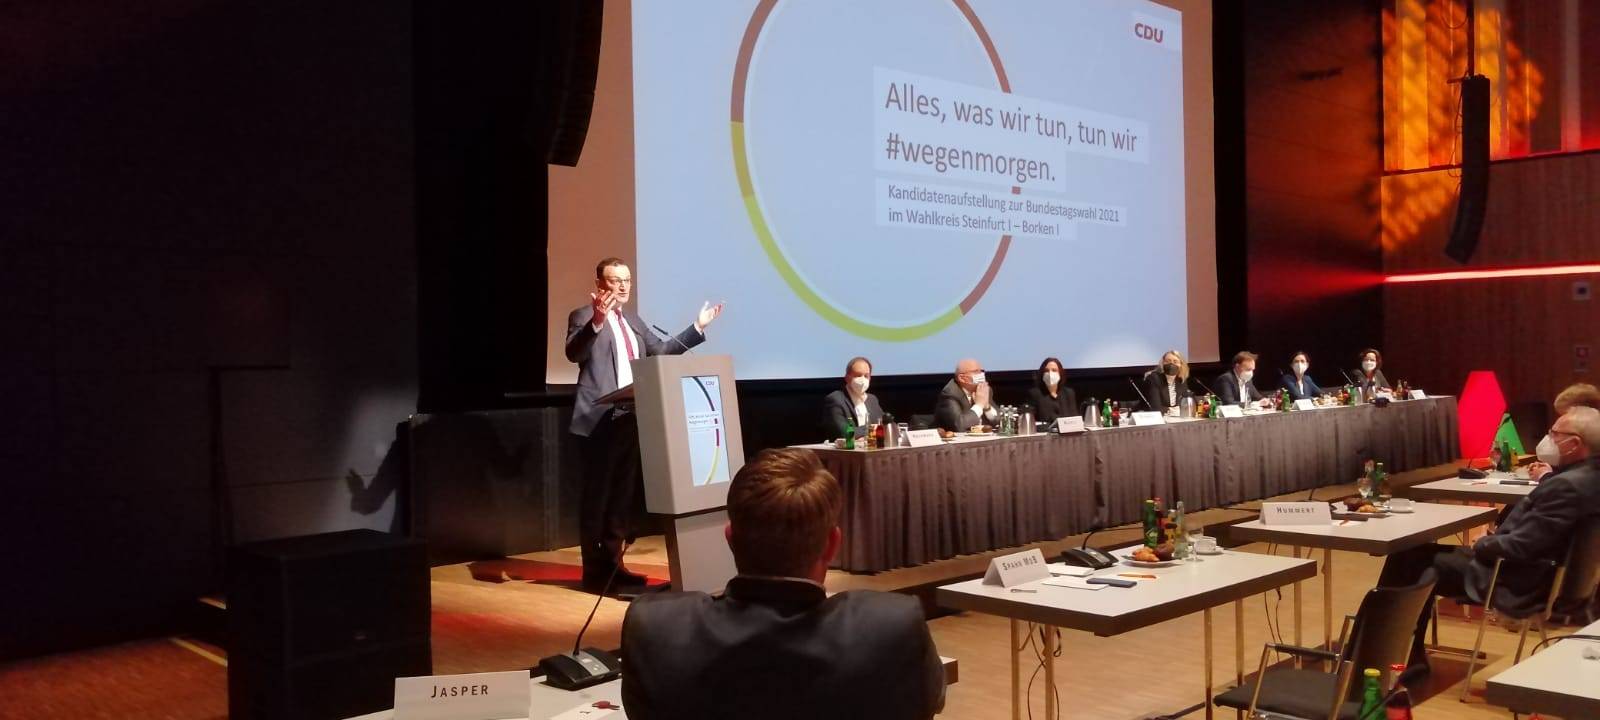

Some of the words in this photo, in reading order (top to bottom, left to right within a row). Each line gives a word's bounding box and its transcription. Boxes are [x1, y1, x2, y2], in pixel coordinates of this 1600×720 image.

[1135, 22, 1164, 44] CDU
[885, 82, 947, 124] Alles,
[954, 100, 994, 127] was
[1000, 106, 1031, 133] wir
[1036, 112, 1073, 145] tun,
[1077, 120, 1107, 147] tun
[1111, 128, 1138, 152] wir
[885, 132, 1057, 183] #wegenmorgen.
[888, 184, 1007, 213] Kandidatenaufstellung
[1008, 201, 1024, 213] zur
[1026, 201, 1098, 221] Bundestagswahl
[1099, 207, 1120, 223] 2021
[888, 207, 904, 223] im
[906, 209, 960, 228] Wahlkreis
[962, 214, 1007, 231] Steinfurt
[1022, 219, 1055, 236] Borken
[431, 684, 489, 698] JASPER
